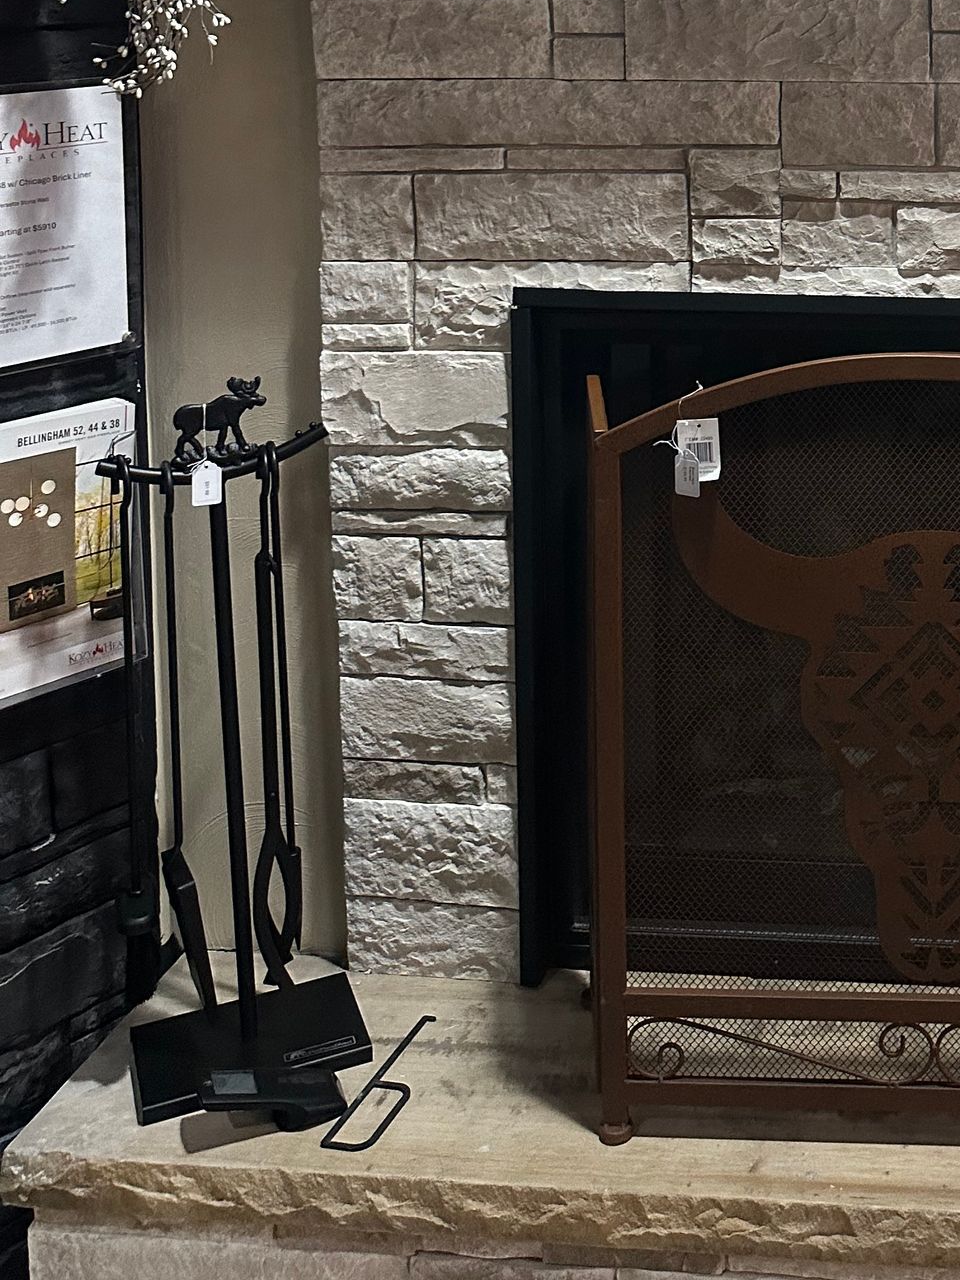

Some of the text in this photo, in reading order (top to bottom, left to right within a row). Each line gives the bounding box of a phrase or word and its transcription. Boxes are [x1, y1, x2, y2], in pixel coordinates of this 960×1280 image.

[43, 121, 108, 146] HEAT
[5, 148, 80, 164] EPLACES
[18, 176, 51, 188] Chicago
[52, 173, 72, 182] Brick
[72, 170, 92, 180] Liner
[0, 222, 57, 237] arting at $5910
[17, 427, 71, 448] BELLINGHAM
[73, 425, 86, 436] 52,
[88, 422, 99, 433] 44
[101, 420, 108, 430] &
[110, 418, 120, 429] 38
[103, 640, 124, 653] HEA
